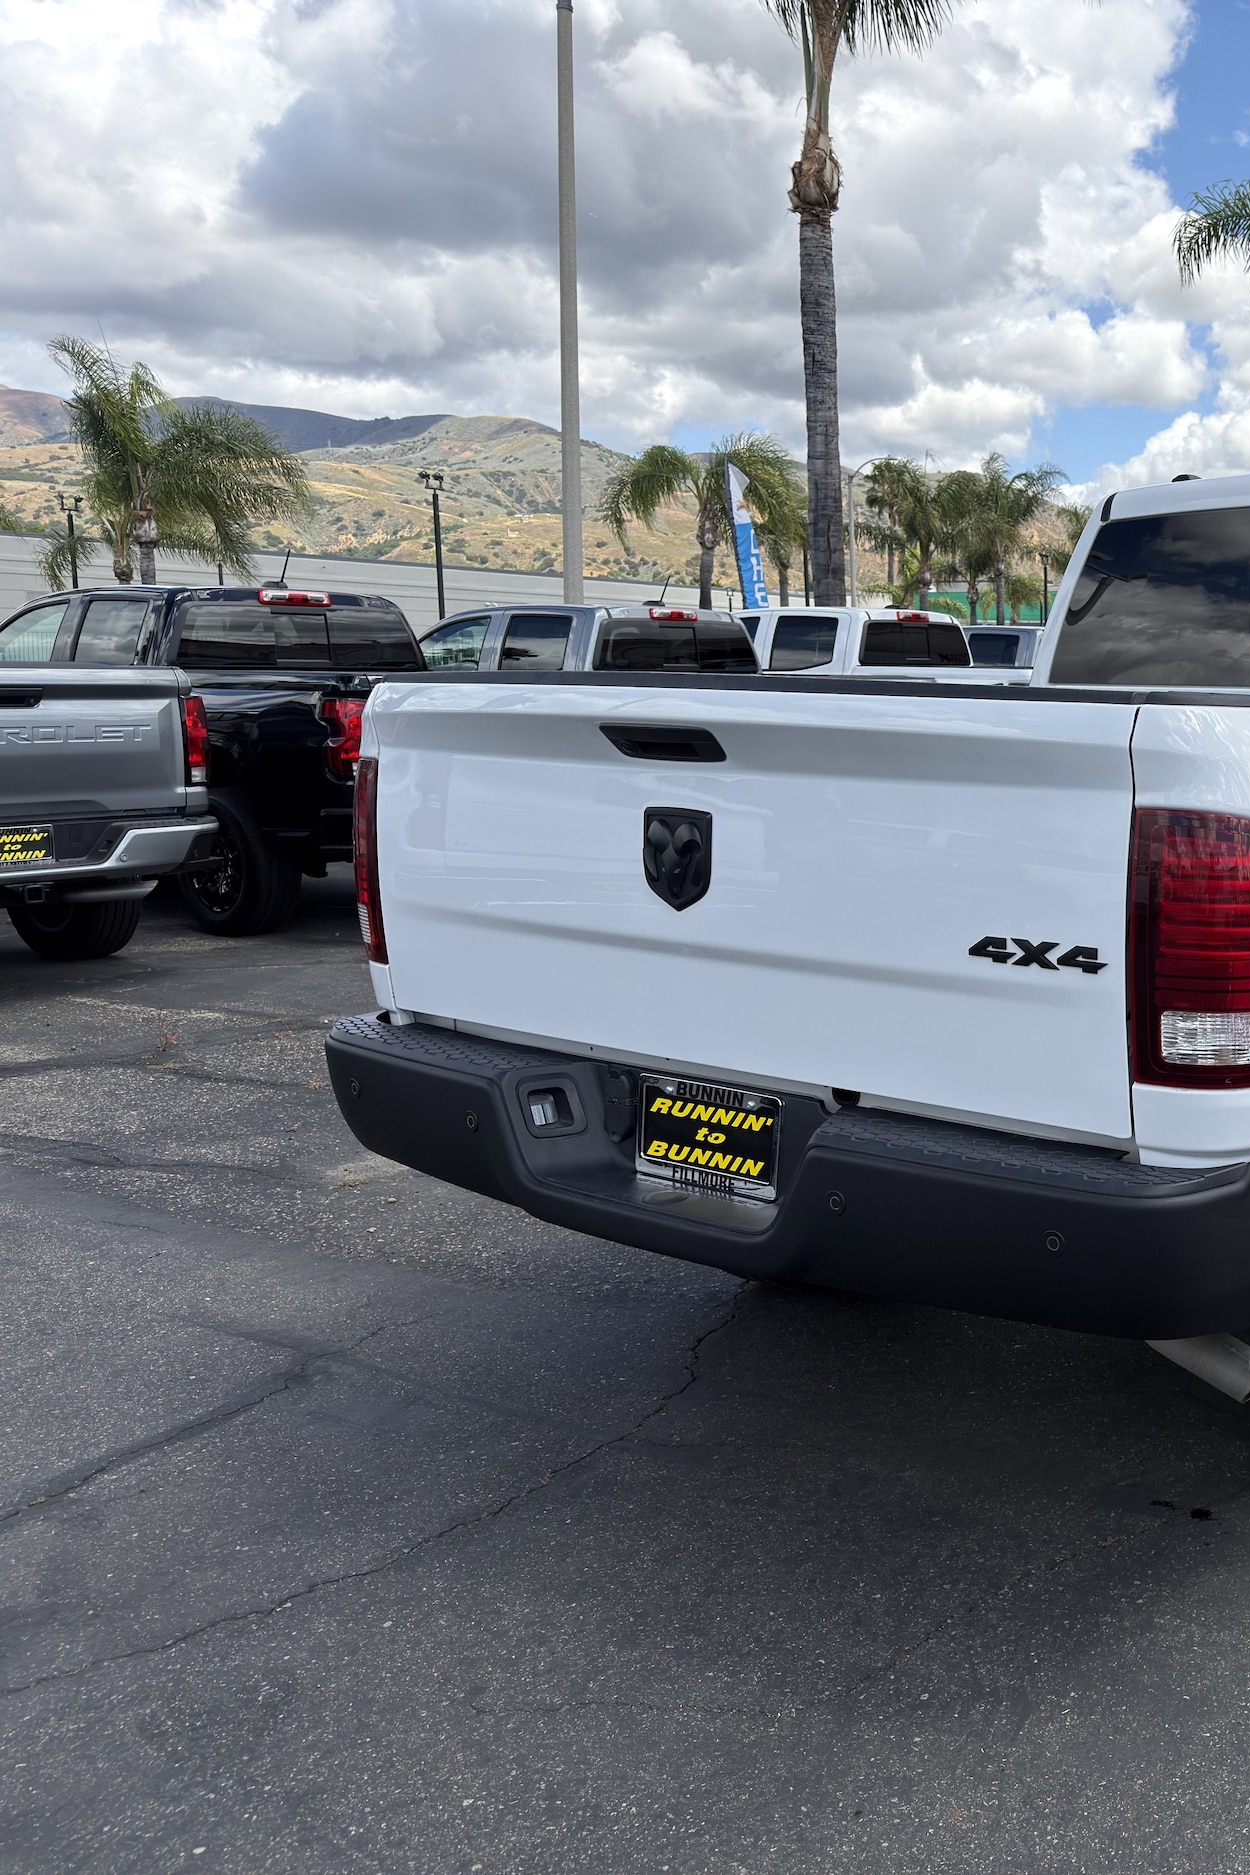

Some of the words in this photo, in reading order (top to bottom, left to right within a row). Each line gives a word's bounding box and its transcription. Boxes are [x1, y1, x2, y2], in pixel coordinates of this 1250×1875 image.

[0, 850, 46, 861] NNIN
[968, 936, 1109, 975] 4X4
[676, 1081, 744, 1108] BUNNIN
[650, 1097, 774, 1132] RUNNIN'
[695, 1127, 727, 1144] to
[646, 1140, 765, 1177] BUNNIN
[672, 1166, 735, 1191] FILLMORE
